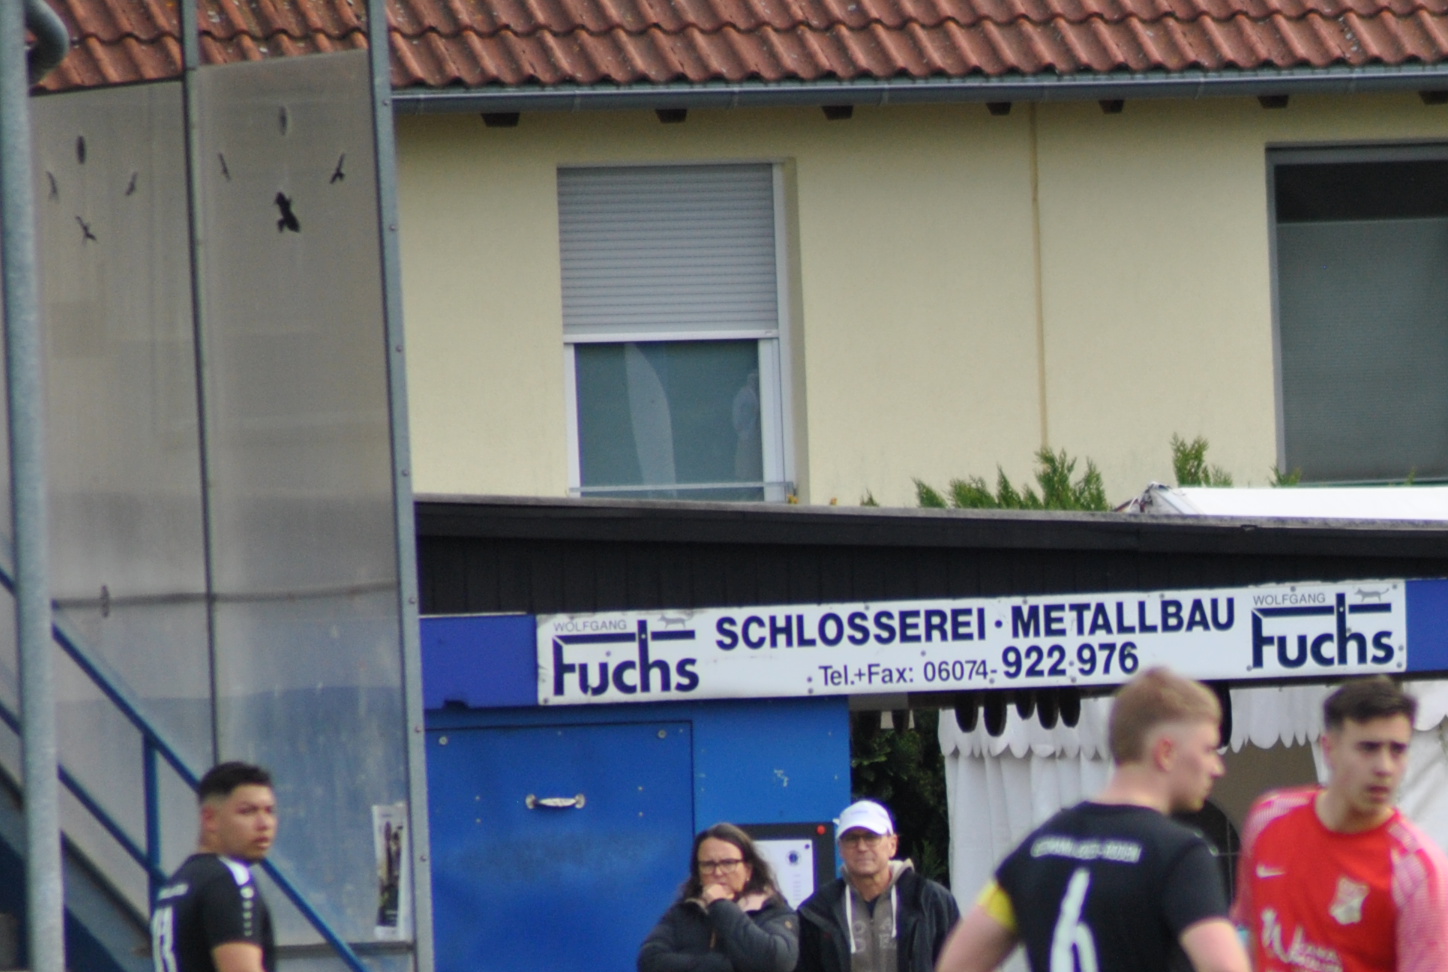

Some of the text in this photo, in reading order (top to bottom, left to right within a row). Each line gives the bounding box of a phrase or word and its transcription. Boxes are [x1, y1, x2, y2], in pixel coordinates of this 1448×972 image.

[1252, 592, 1326, 606] WOLFGANG
[552, 619, 628, 632] WOLFGANG
[716, 607, 986, 651] SCHLOSSEREI
[1011, 597, 1236, 639] METALLBAU
[1251, 592, 1395, 669] Fuchs
[552, 619, 700, 697] Fuchs
[819, 663, 914, 687] Tel.+Fax:
